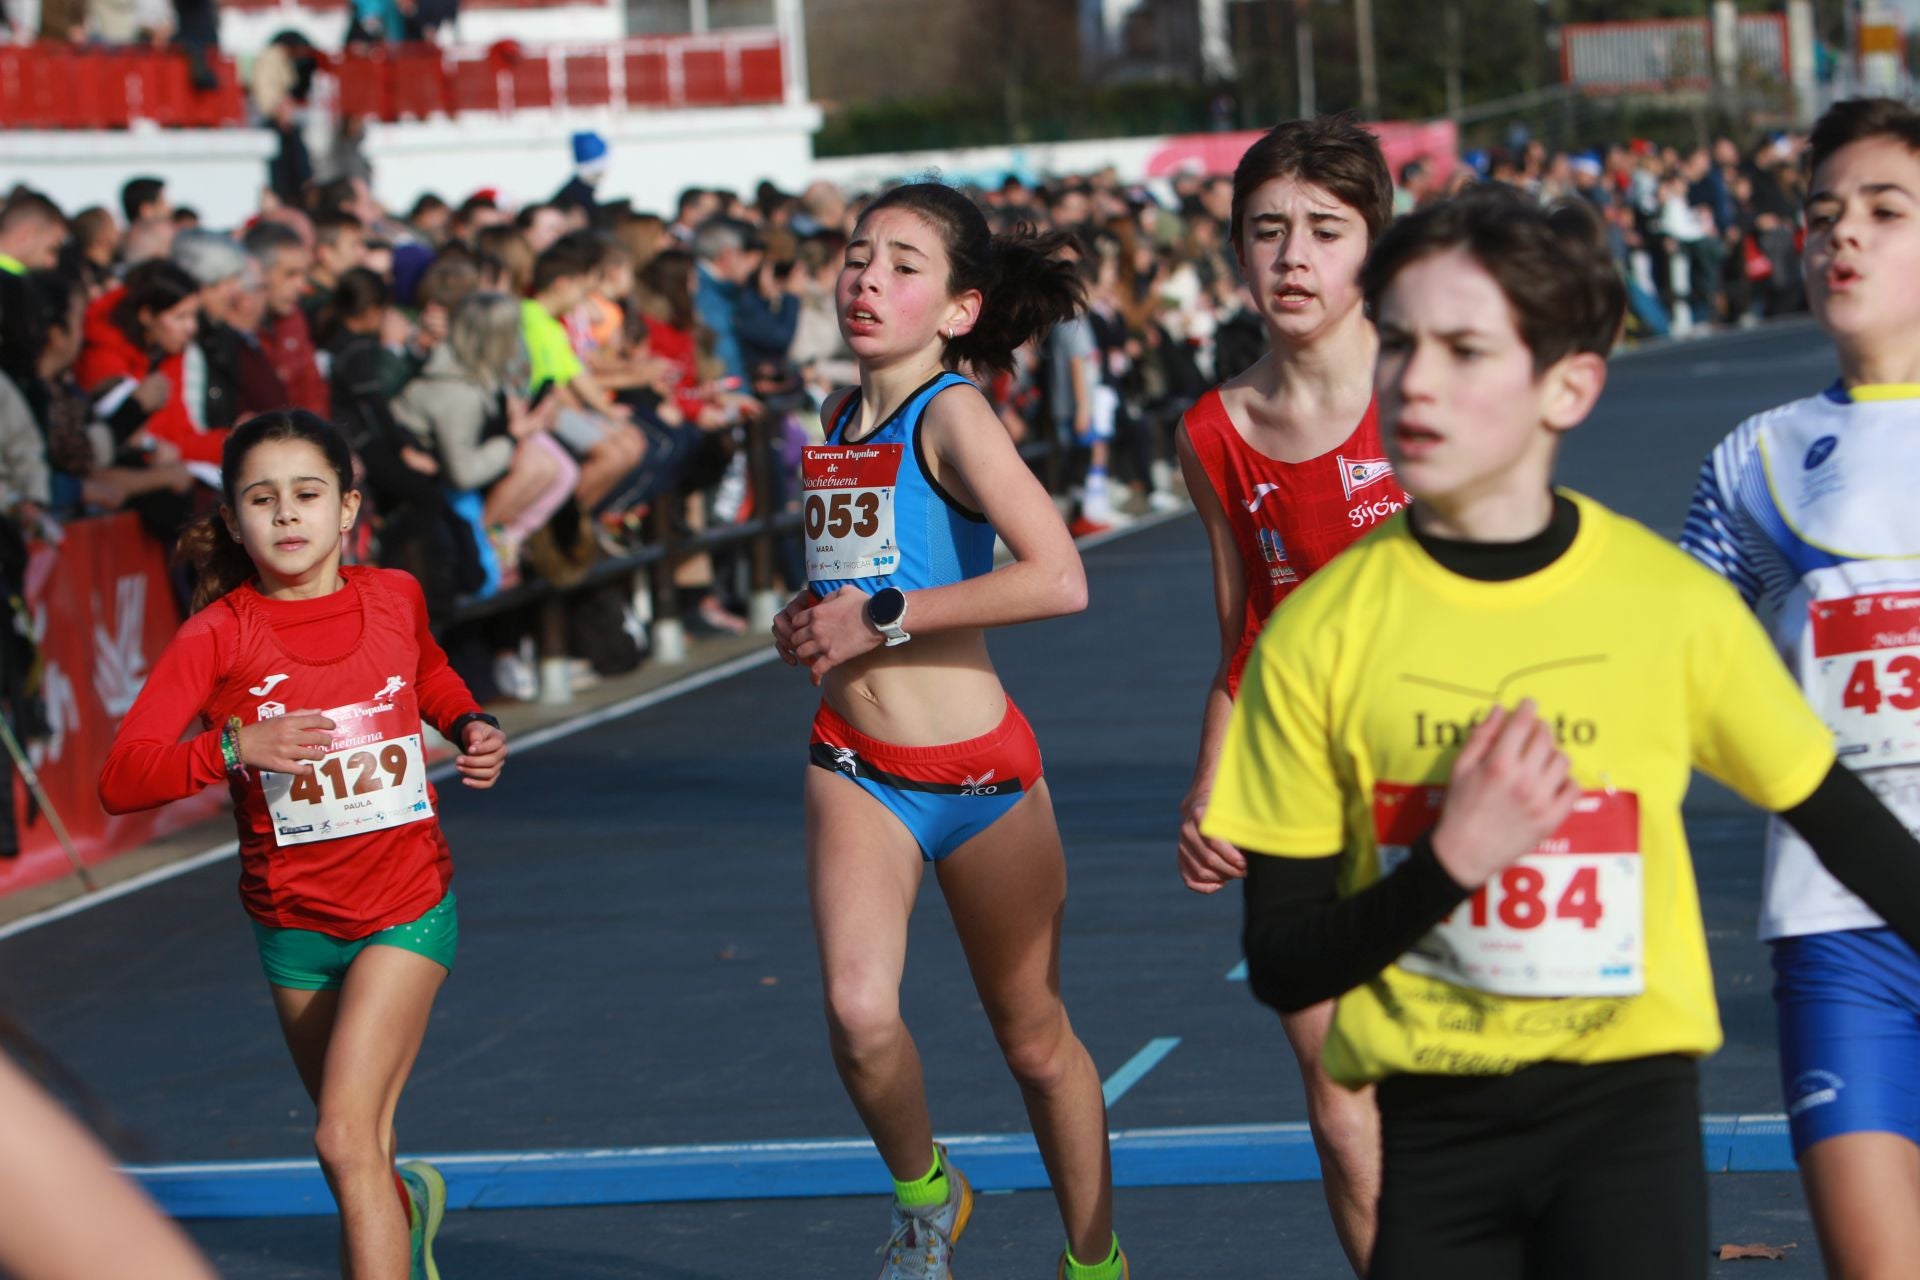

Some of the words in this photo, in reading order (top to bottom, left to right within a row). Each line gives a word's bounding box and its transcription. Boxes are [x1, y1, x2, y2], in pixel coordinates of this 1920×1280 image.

[806, 449, 844, 460] Carrera
[845, 448, 880, 461] Popular
[827, 463, 839, 473] de
[816, 545, 834, 553] MARA
[354, 702, 394, 719] Popular
[288, 743, 408, 806] 4129
[344, 799, 373, 812] PAULA
